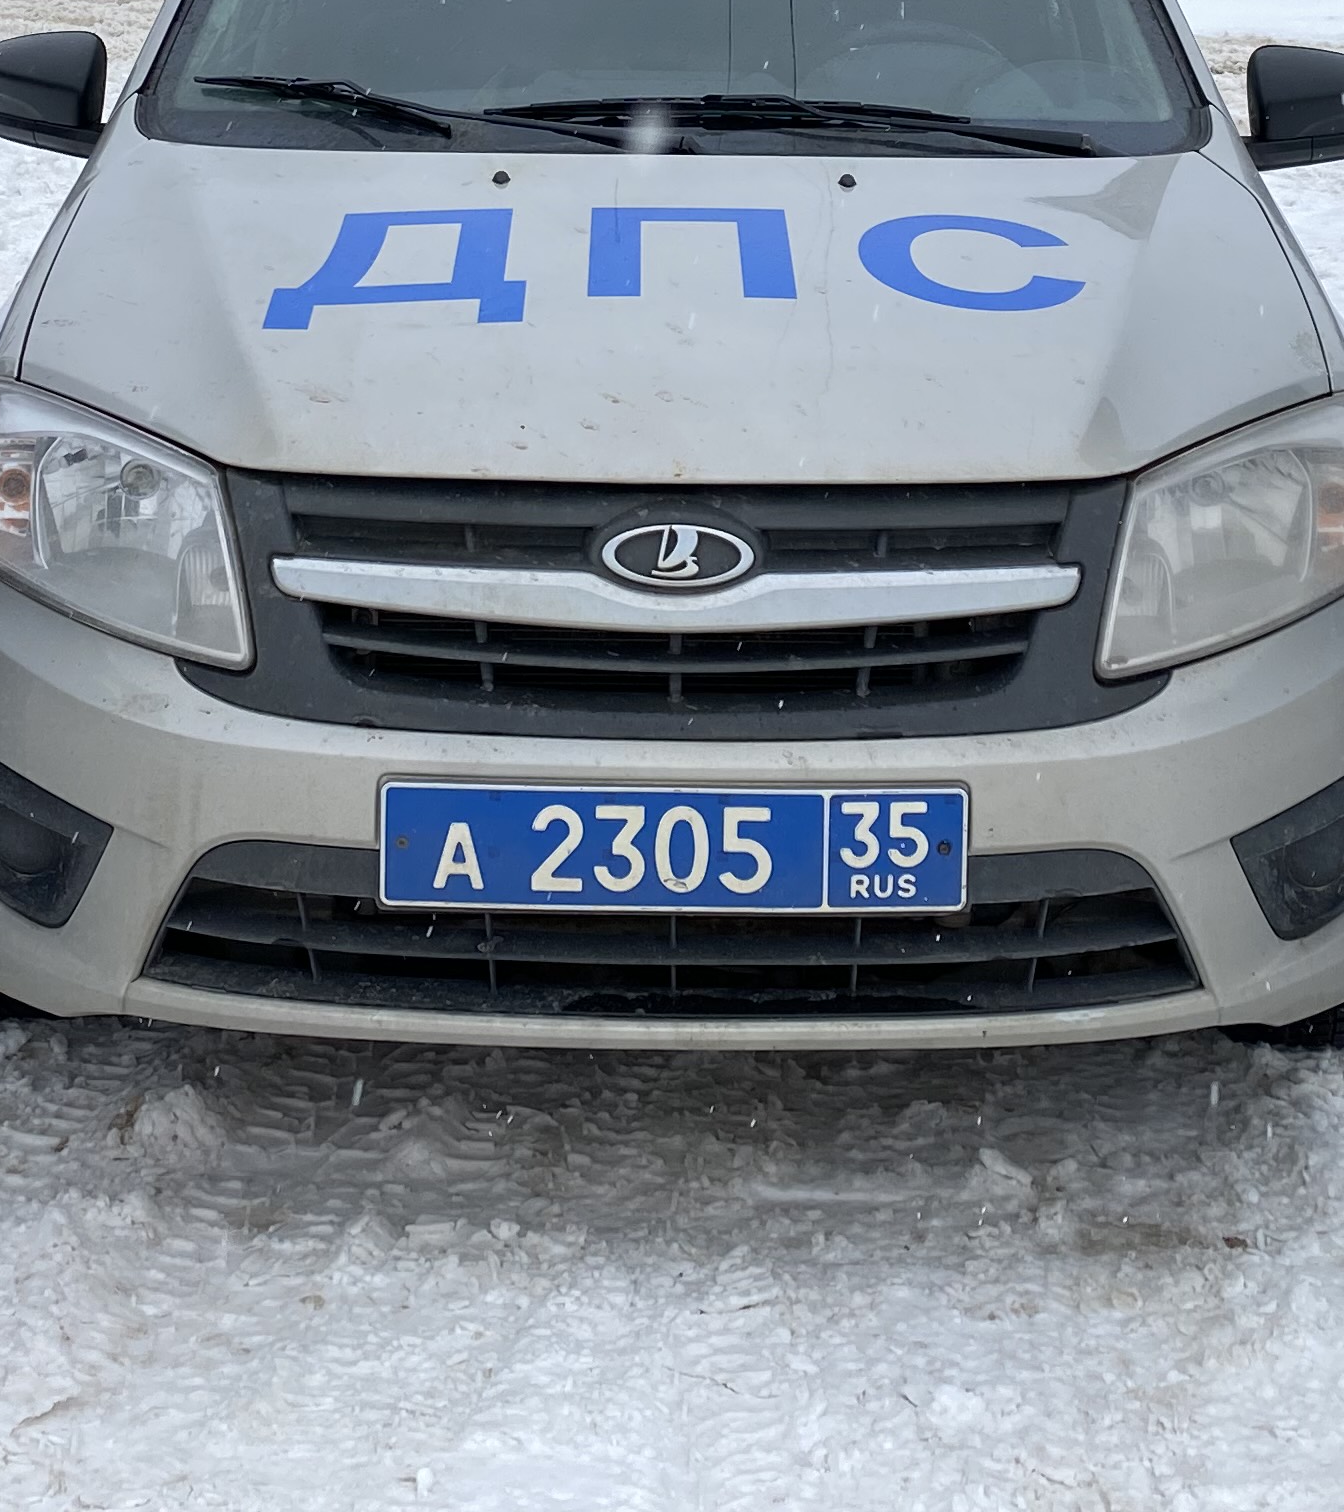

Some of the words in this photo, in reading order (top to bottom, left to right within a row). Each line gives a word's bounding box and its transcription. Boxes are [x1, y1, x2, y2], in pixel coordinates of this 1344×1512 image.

[262, 207, 1087, 330] ДПС
[530, 804, 773, 894] 2305
[840, 801, 930, 868] 35
[850, 874, 918, 898] RUS
